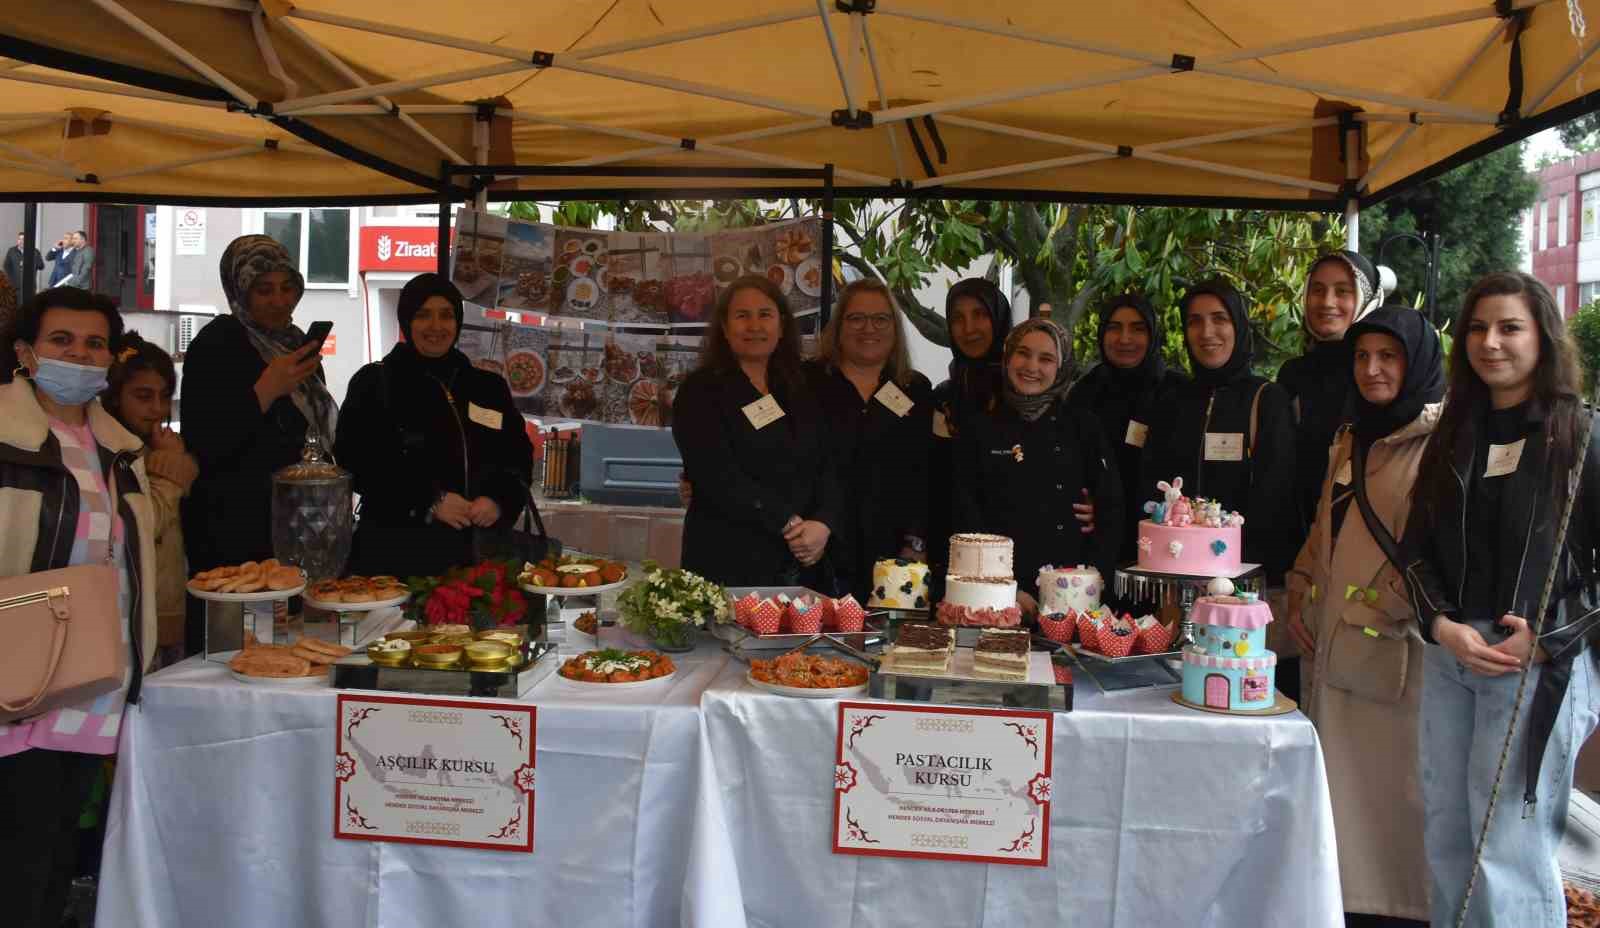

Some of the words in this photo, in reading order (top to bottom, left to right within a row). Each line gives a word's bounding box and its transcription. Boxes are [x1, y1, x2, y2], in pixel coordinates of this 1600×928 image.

[394, 241, 437, 257] Ziraat
[376, 755, 437, 771] AŞÇILIK
[441, 759, 495, 774] KURSU
[896, 752, 993, 771] PASTACILIK
[915, 771, 972, 787] KURSU
